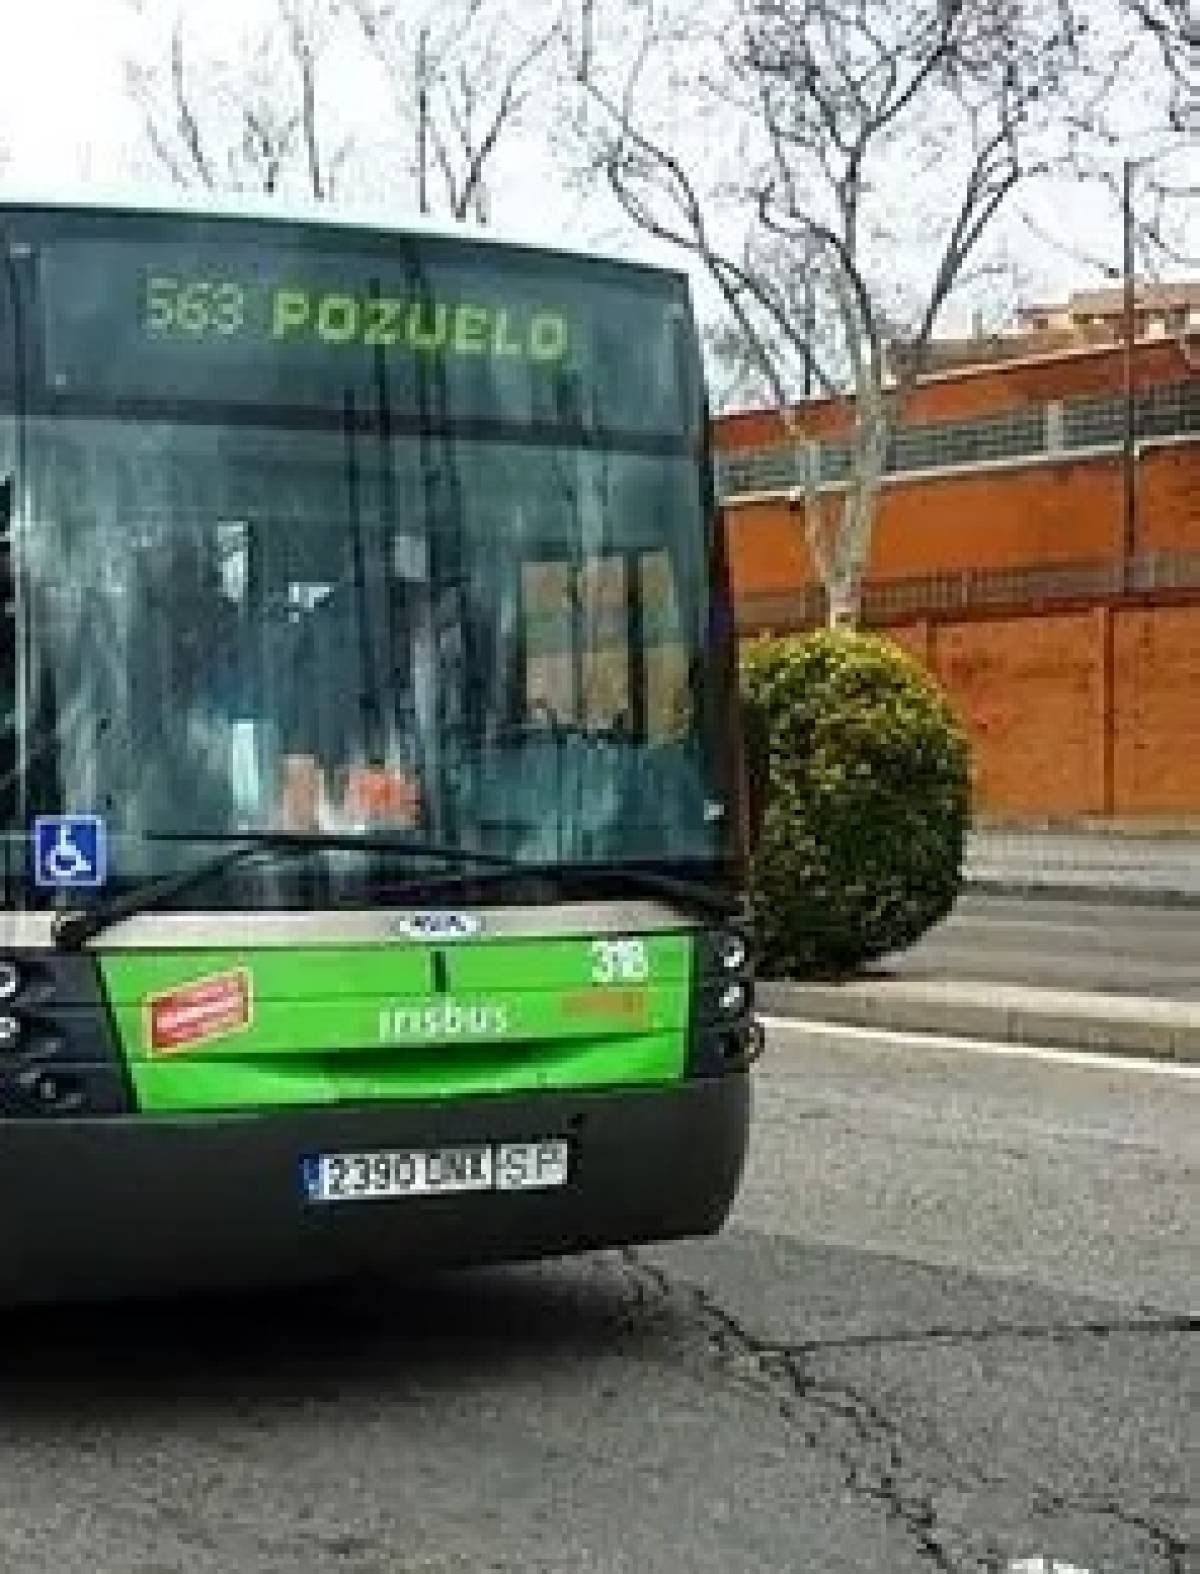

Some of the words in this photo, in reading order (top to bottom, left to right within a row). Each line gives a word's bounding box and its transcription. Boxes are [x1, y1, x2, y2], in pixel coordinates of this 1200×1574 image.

[147, 278, 244, 336] 563
[272, 291, 569, 361] POZUELO
[327, 1150, 414, 1195] 2390
